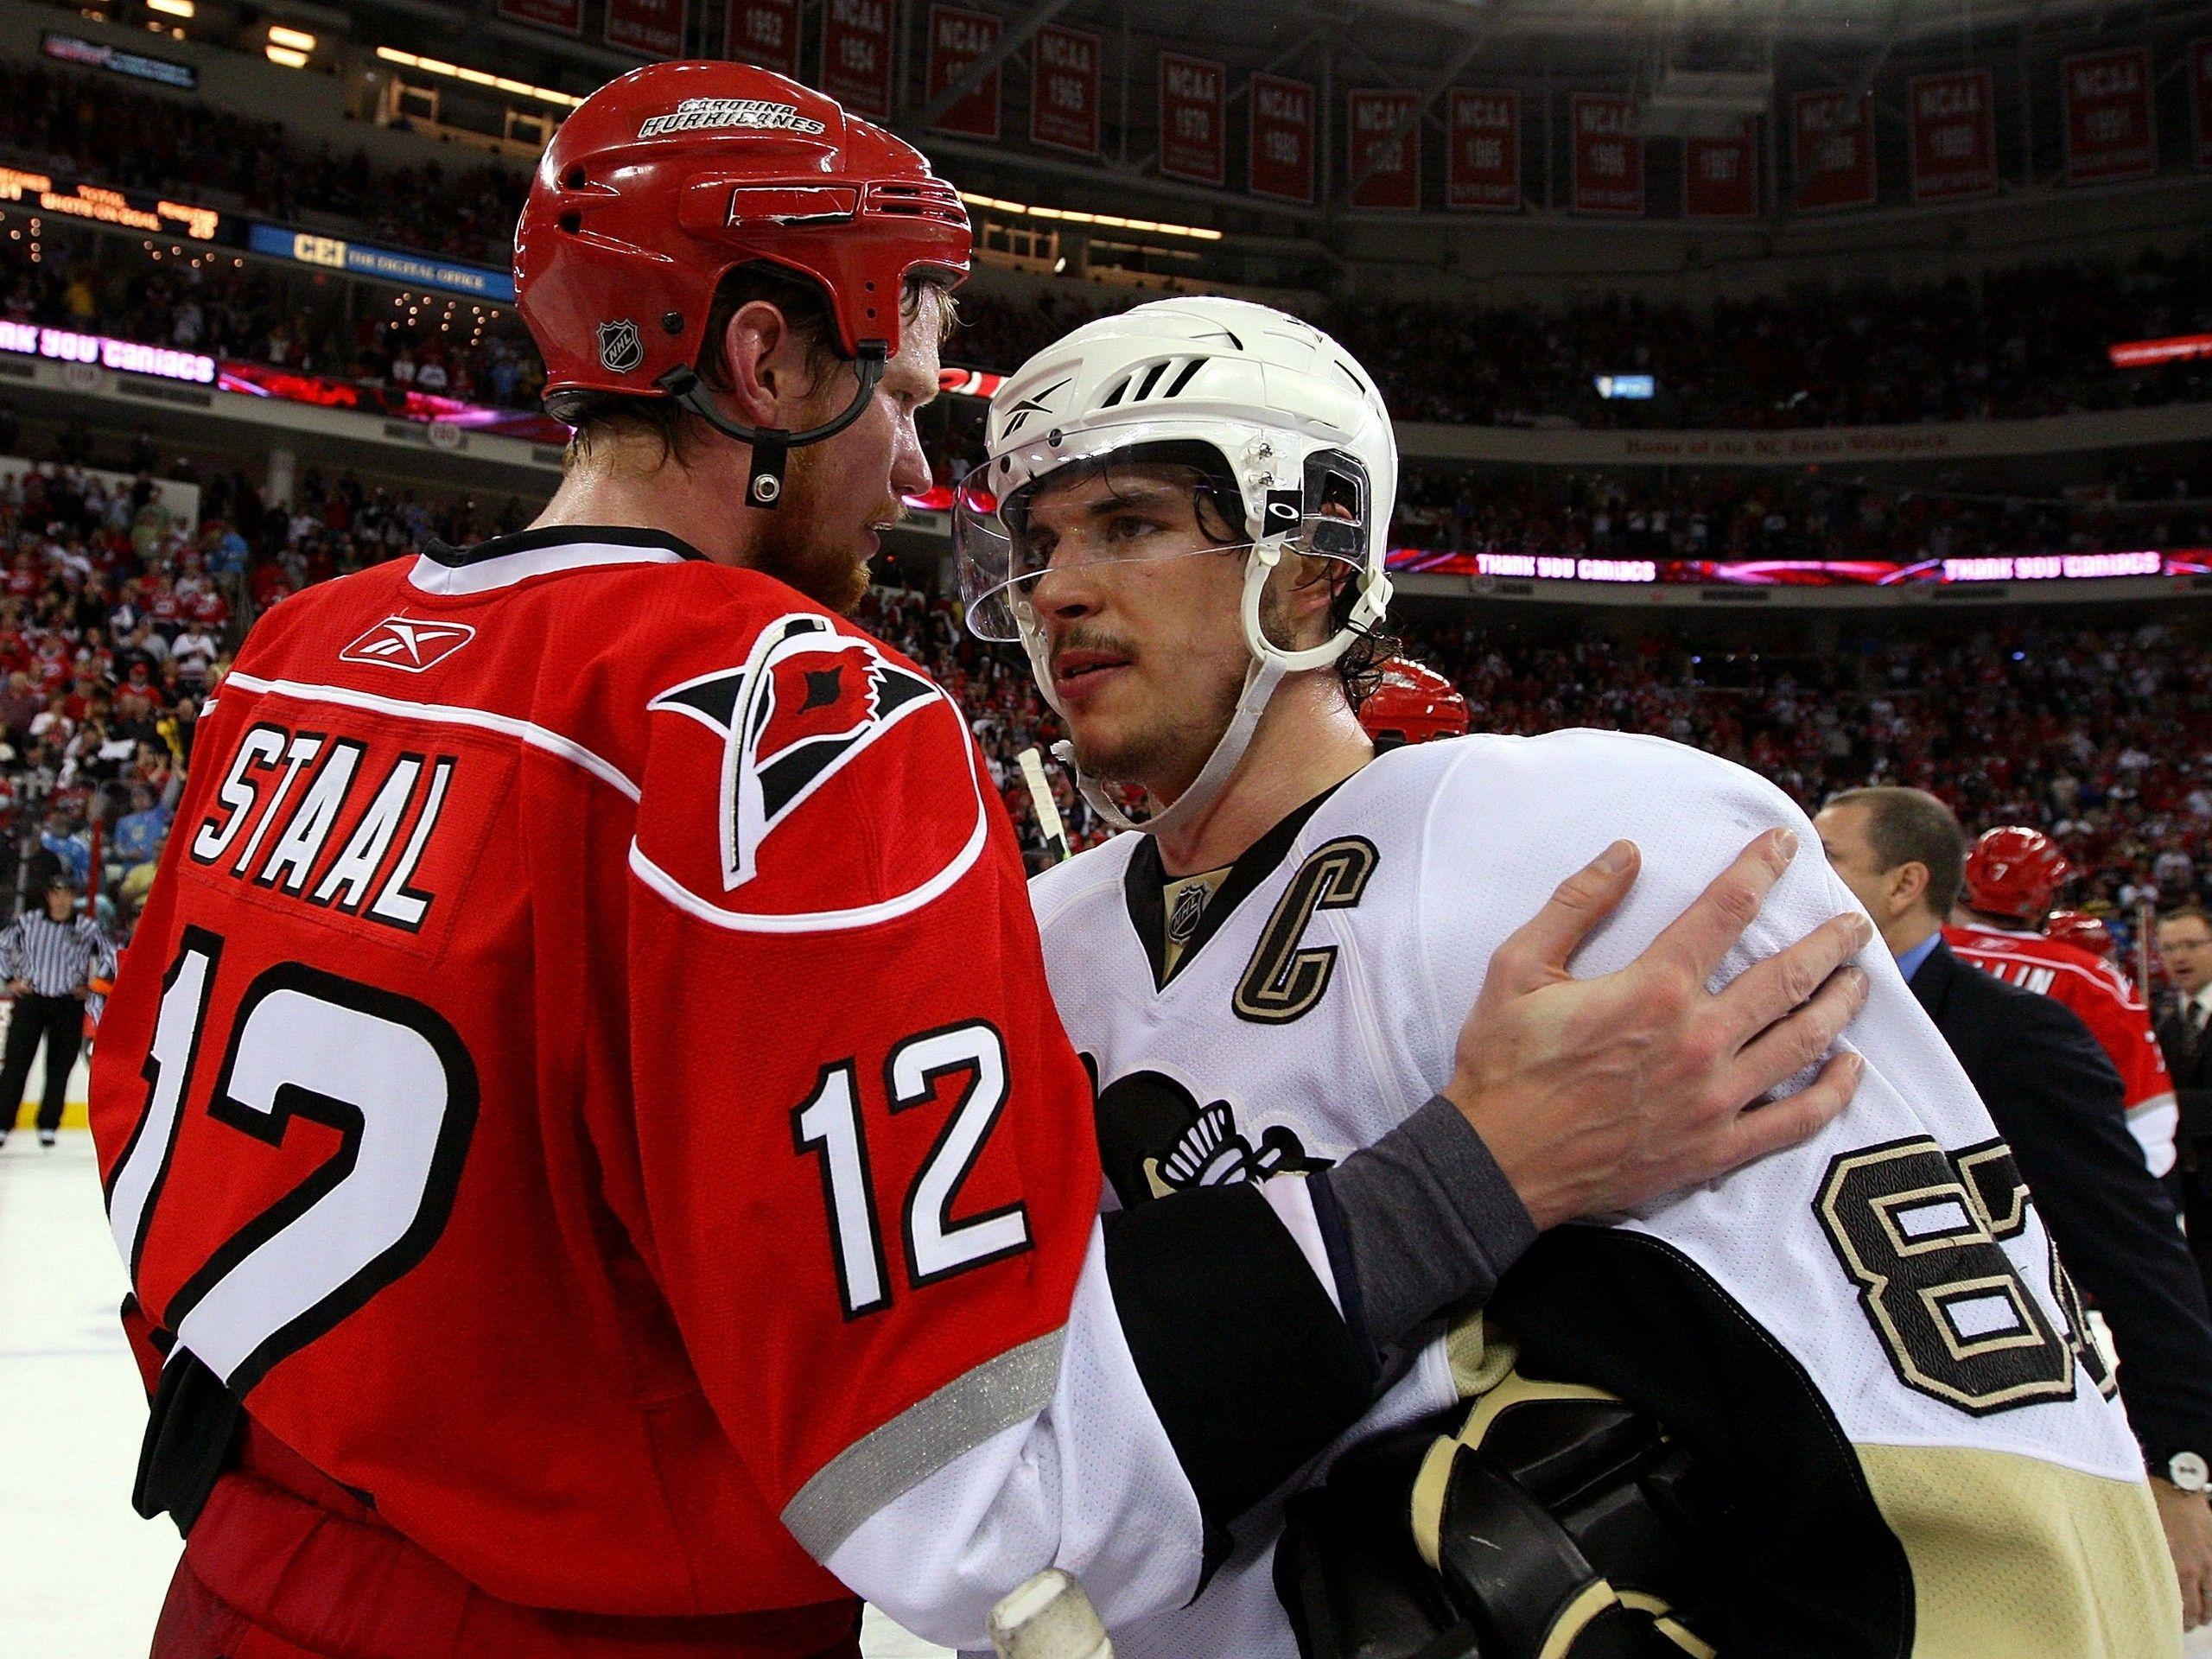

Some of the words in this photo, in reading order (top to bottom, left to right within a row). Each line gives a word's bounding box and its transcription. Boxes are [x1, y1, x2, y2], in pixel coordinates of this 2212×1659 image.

[1041, 34, 1090, 73] NCAA
[1169, 65, 1216, 103] NCAA
[638, 111, 825, 138] HURRICANES
[677, 98, 798, 117] CAROLINA
[1258, 87, 1305, 124] NCAA
[349, 251, 375, 267] THE
[377, 257, 434, 278] DIGITAL
[436, 269, 484, 289] OFFICE
[609, 334, 632, 362] NHL
[188, 721, 458, 932] STAAL
[1231, 835, 1381, 1025] C
[104, 923, 480, 1398] 12
[789, 1017, 1035, 1322] 12
